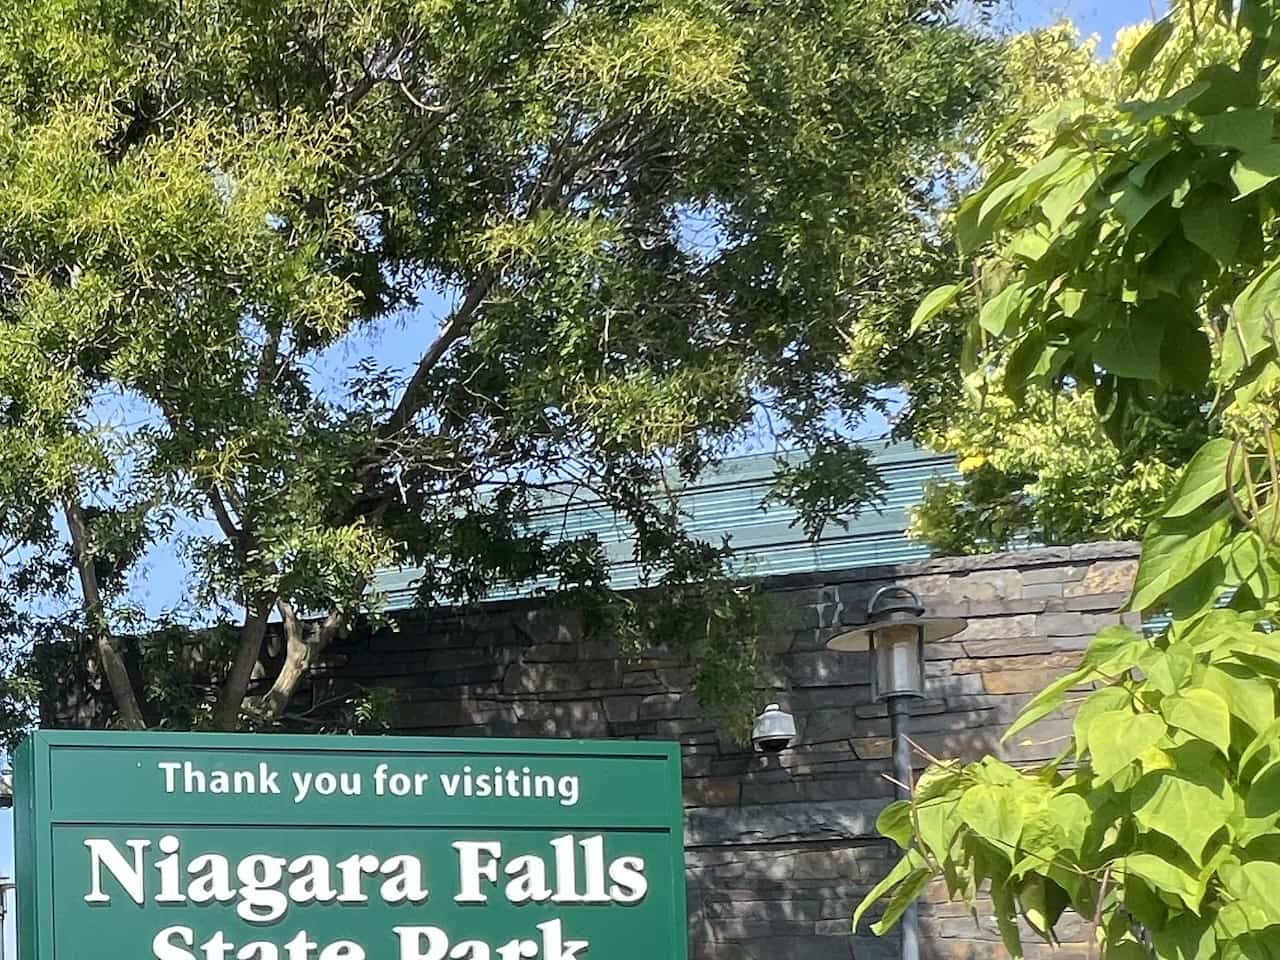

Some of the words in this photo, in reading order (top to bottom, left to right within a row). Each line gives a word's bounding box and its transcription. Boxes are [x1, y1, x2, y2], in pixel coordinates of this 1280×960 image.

[157, 760, 281, 794] Thank
[291, 771, 361, 803] you
[373, 763, 429, 796] for
[439, 765, 579, 806] visiting
[83, 834, 429, 922] Niagara
[451, 834, 648, 903] Falls
